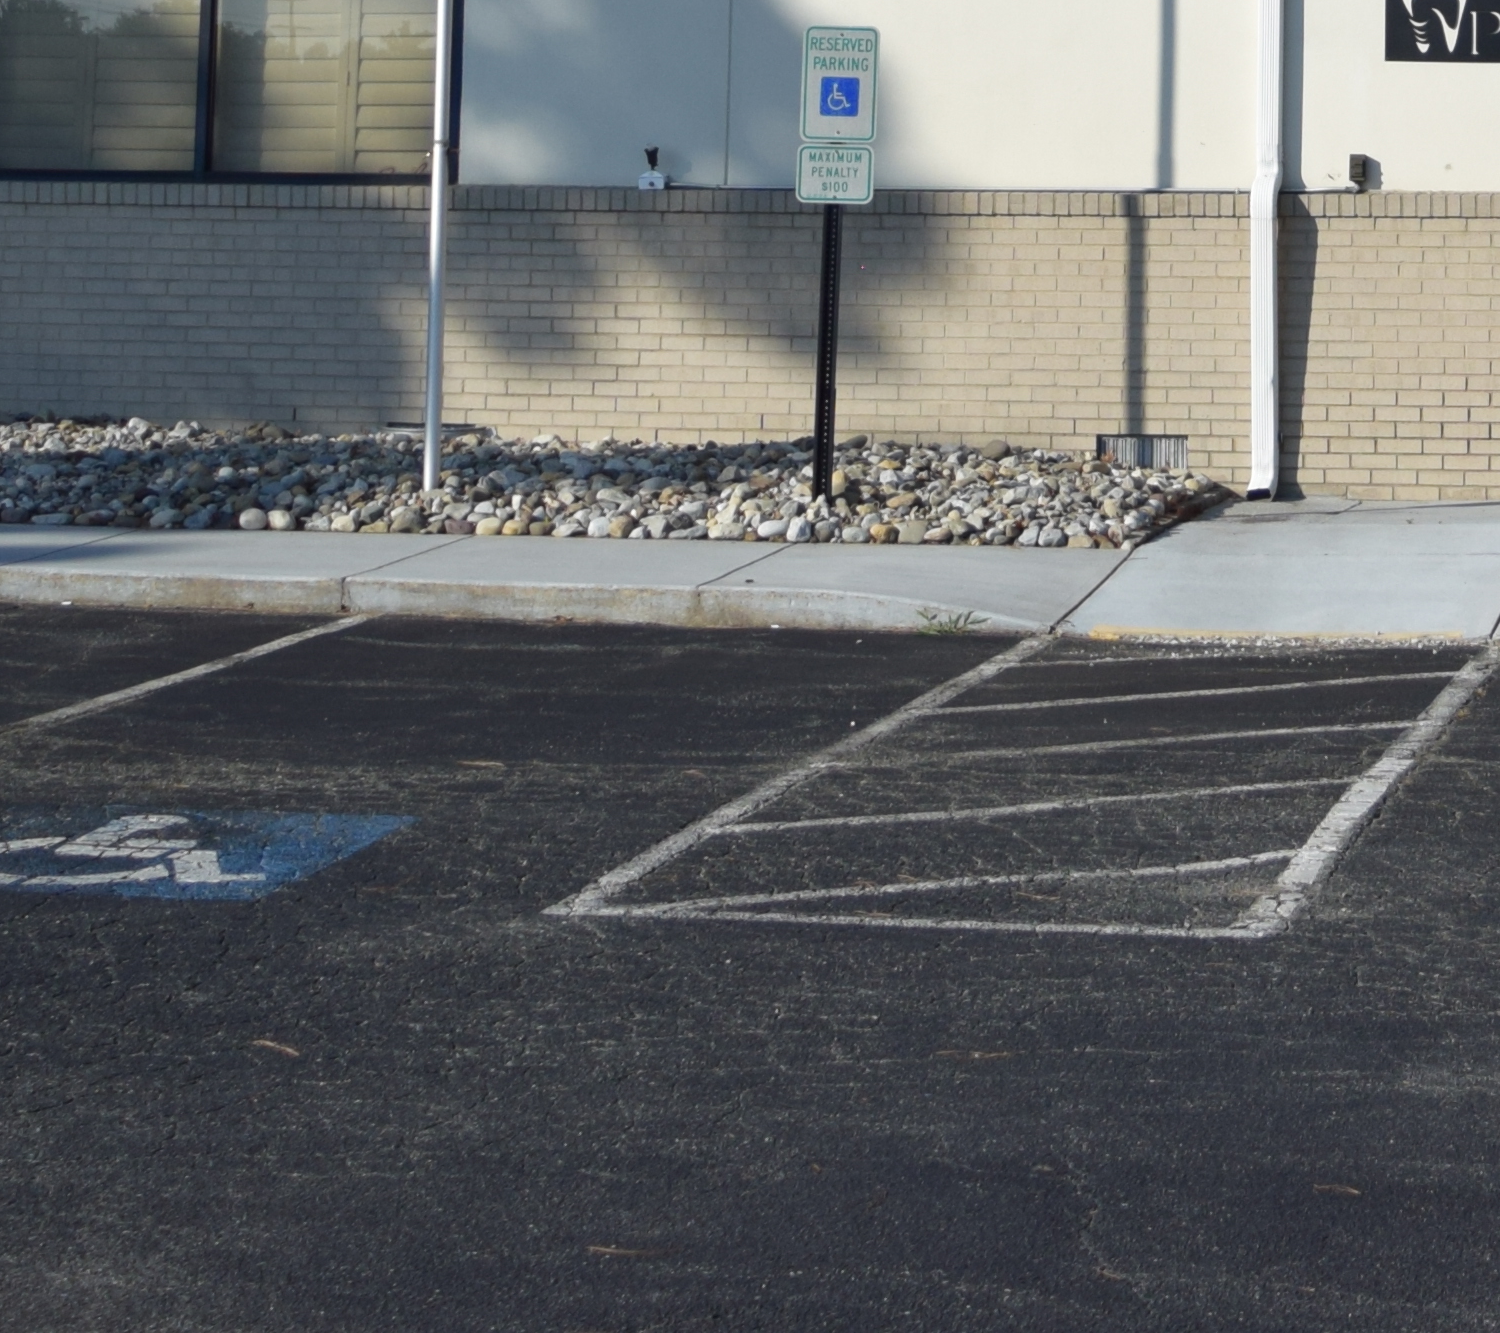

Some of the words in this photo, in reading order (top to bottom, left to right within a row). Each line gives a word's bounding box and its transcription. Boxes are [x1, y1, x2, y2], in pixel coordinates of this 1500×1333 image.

[810, 37, 873, 52] RESERVED
[813, 56, 869, 72] PARKING
[809, 152, 862, 163] MAXIMUM
[811, 166, 859, 178] PENALTY
